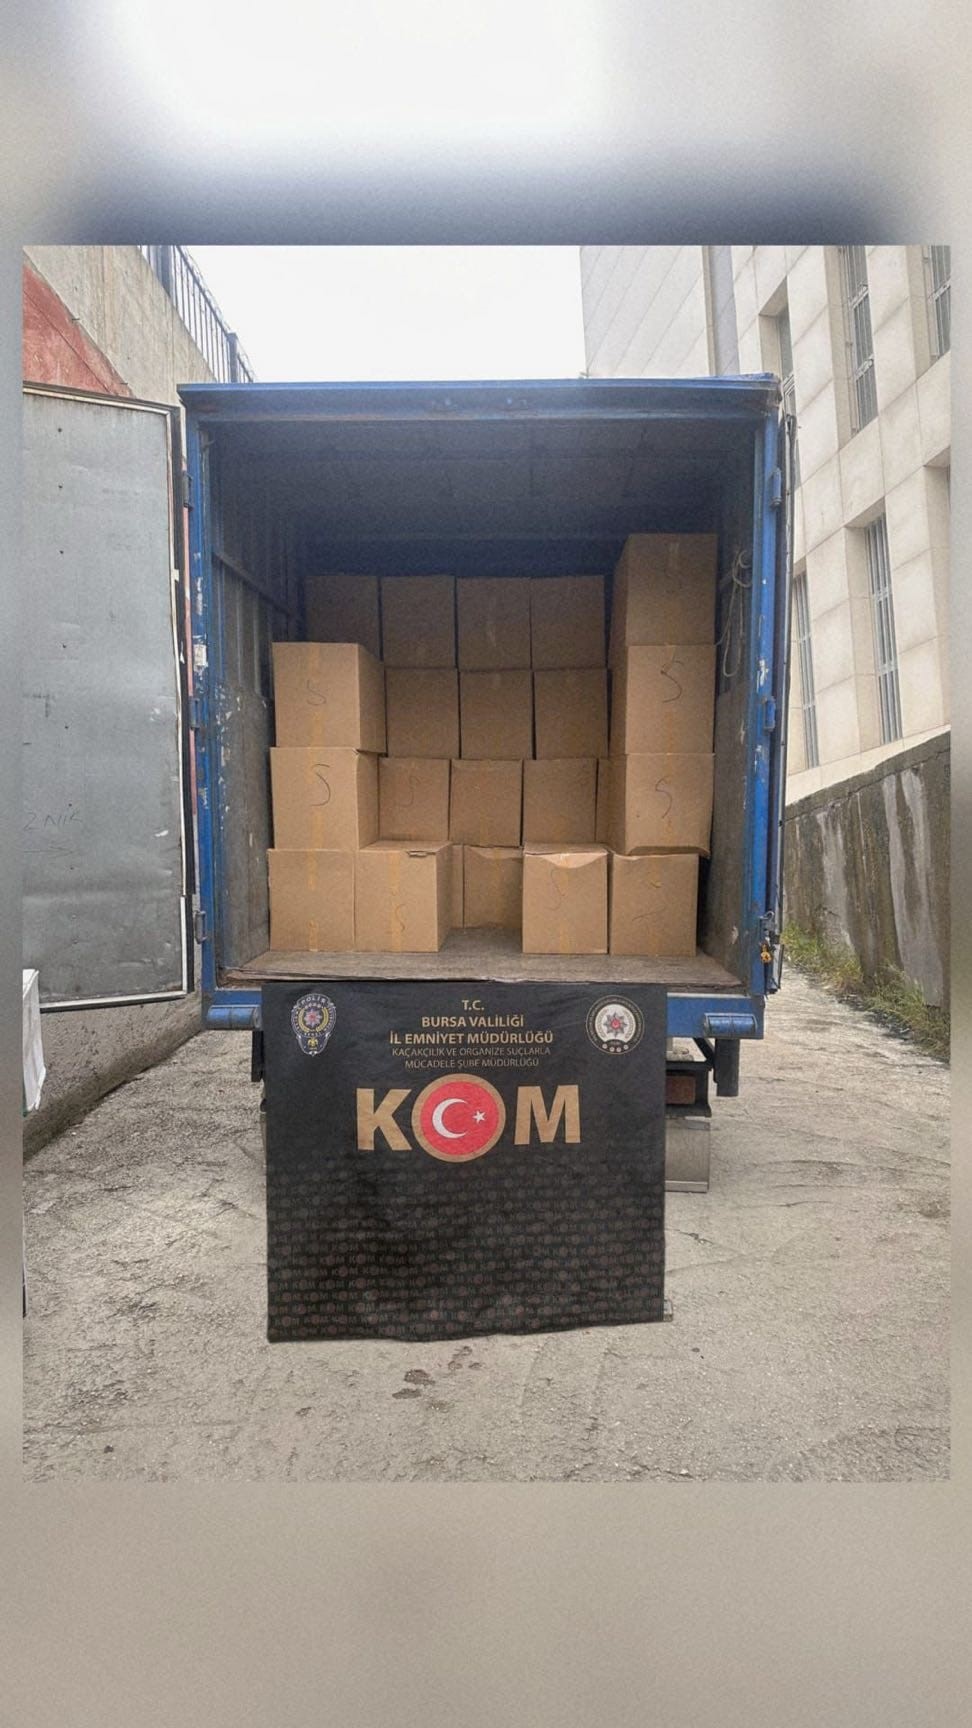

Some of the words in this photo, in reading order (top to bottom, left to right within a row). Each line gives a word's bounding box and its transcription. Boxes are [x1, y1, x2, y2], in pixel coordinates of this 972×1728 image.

[461, 999, 485, 1011] T.C.
[421, 1016, 467, 1028] BURSA
[468, 1014, 524, 1027] VALİLİĞİ
[389, 1030, 402, 1045] İL
[405, 1030, 467, 1045] EMNİYET
[467, 1030, 554, 1045] MÜDÜRLÜĞÜ
[446, 1047, 457, 1057] VE
